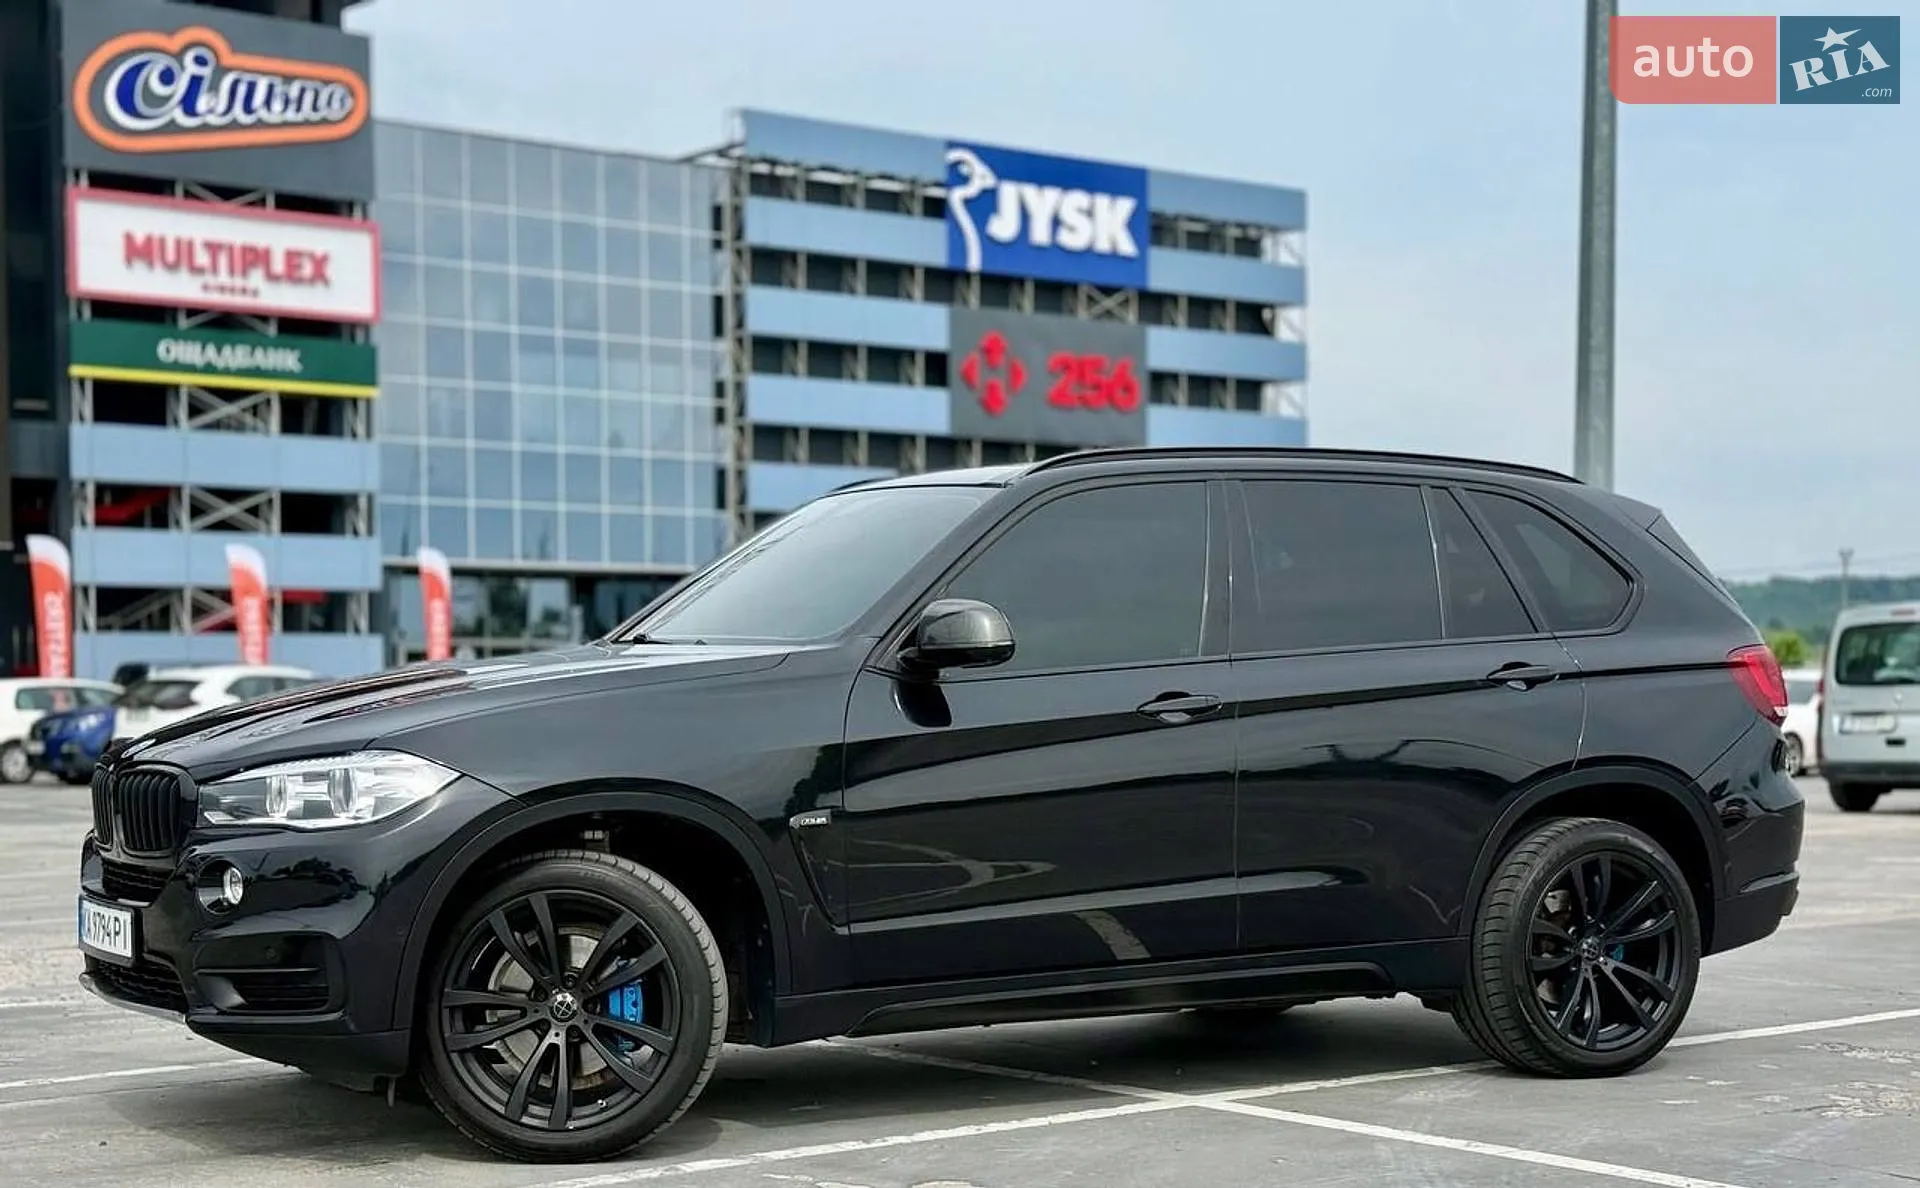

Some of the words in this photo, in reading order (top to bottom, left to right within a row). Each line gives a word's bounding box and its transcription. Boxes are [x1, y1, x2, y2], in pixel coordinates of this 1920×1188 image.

[986, 179, 1139, 257] JYSK
[123, 231, 331, 288] MULTIPLEX
[156, 338, 304, 373] ОЩАДБАНК
[1046, 350, 1141, 413] 256
